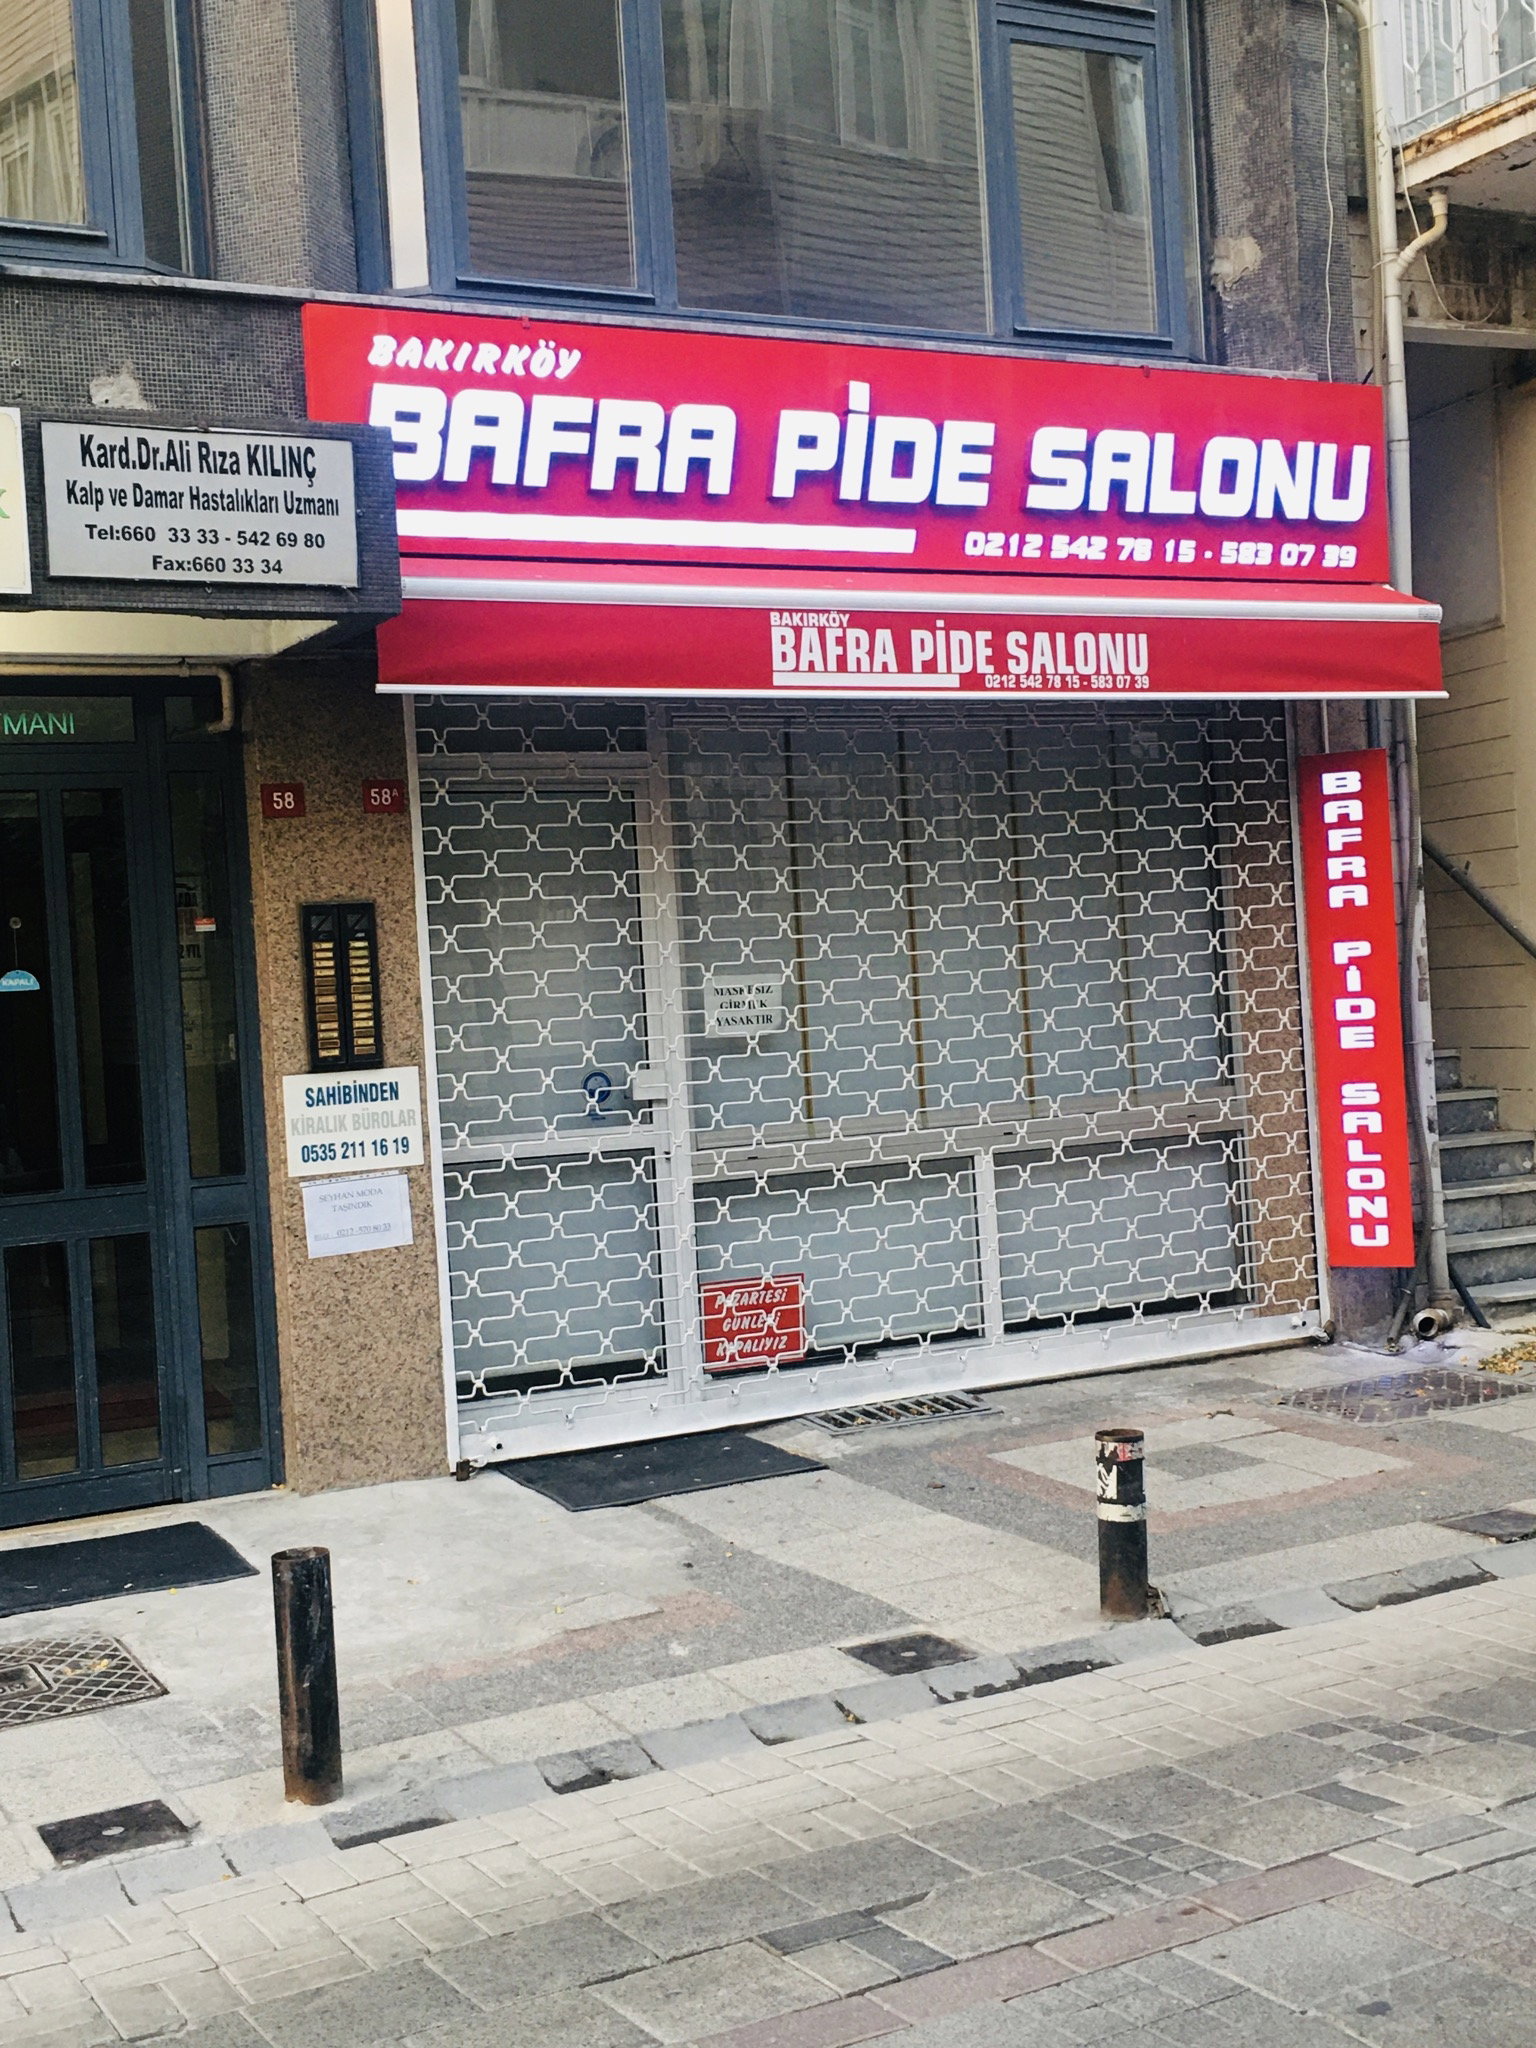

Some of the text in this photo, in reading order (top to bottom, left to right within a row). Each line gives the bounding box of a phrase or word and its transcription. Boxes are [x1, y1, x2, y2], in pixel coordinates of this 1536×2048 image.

[367, 334, 582, 380] BAKIRKÖY
[79, 433, 317, 488] Kard.Dr.Ali Rıza KILINÇ
[368, 380, 1372, 523] BAFRA PİDE SALONU
[66, 479, 339, 516] Kalp ve Damar Hastalıkları Uzmanı
[84, 523, 156, 542] Tel:660
[168, 527, 191, 543] 33
[196, 528, 220, 545] 33
[237, 530, 271, 547] 542
[276, 531, 298, 548] 69
[304, 533, 326, 549] 80
[964, 531, 1042, 558] 0212
[1049, 534, 1108, 561] 542
[1115, 537, 1153, 562] 78
[1164, 539, 1197, 564] 15
[1219, 540, 1273, 566] 583
[1279, 543, 1316, 567] 07
[1321, 544, 1358, 569] 39
[152, 555, 283, 575] Fax:660 33 34
[770, 611, 850, 627] BAKIRKÖY
[770, 619, 1149, 675] BAFRA PİDE SALONU
[985, 675, 1016, 689] 0212
[1019, 675, 1043, 689] 542
[1047, 676, 1062, 689] 78
[1065, 676, 1080, 689] 15
[1090, 676, 1113, 689] 583
[1116, 676, 1131, 689] 07
[1134, 676, 1150, 689] 39
[272, 792, 295, 810] 58
[716, 1014, 773, 1027] YASAKTIR
[1320, 770, 1389, 1248] BAFRA PİDE SALONU
[305, 1080, 400, 1108] SAHİBİNDEN
[290, 1107, 417, 1137] KİRALIK BÜROLAR
[301, 1136, 410, 1164] 0535 211 16 19
